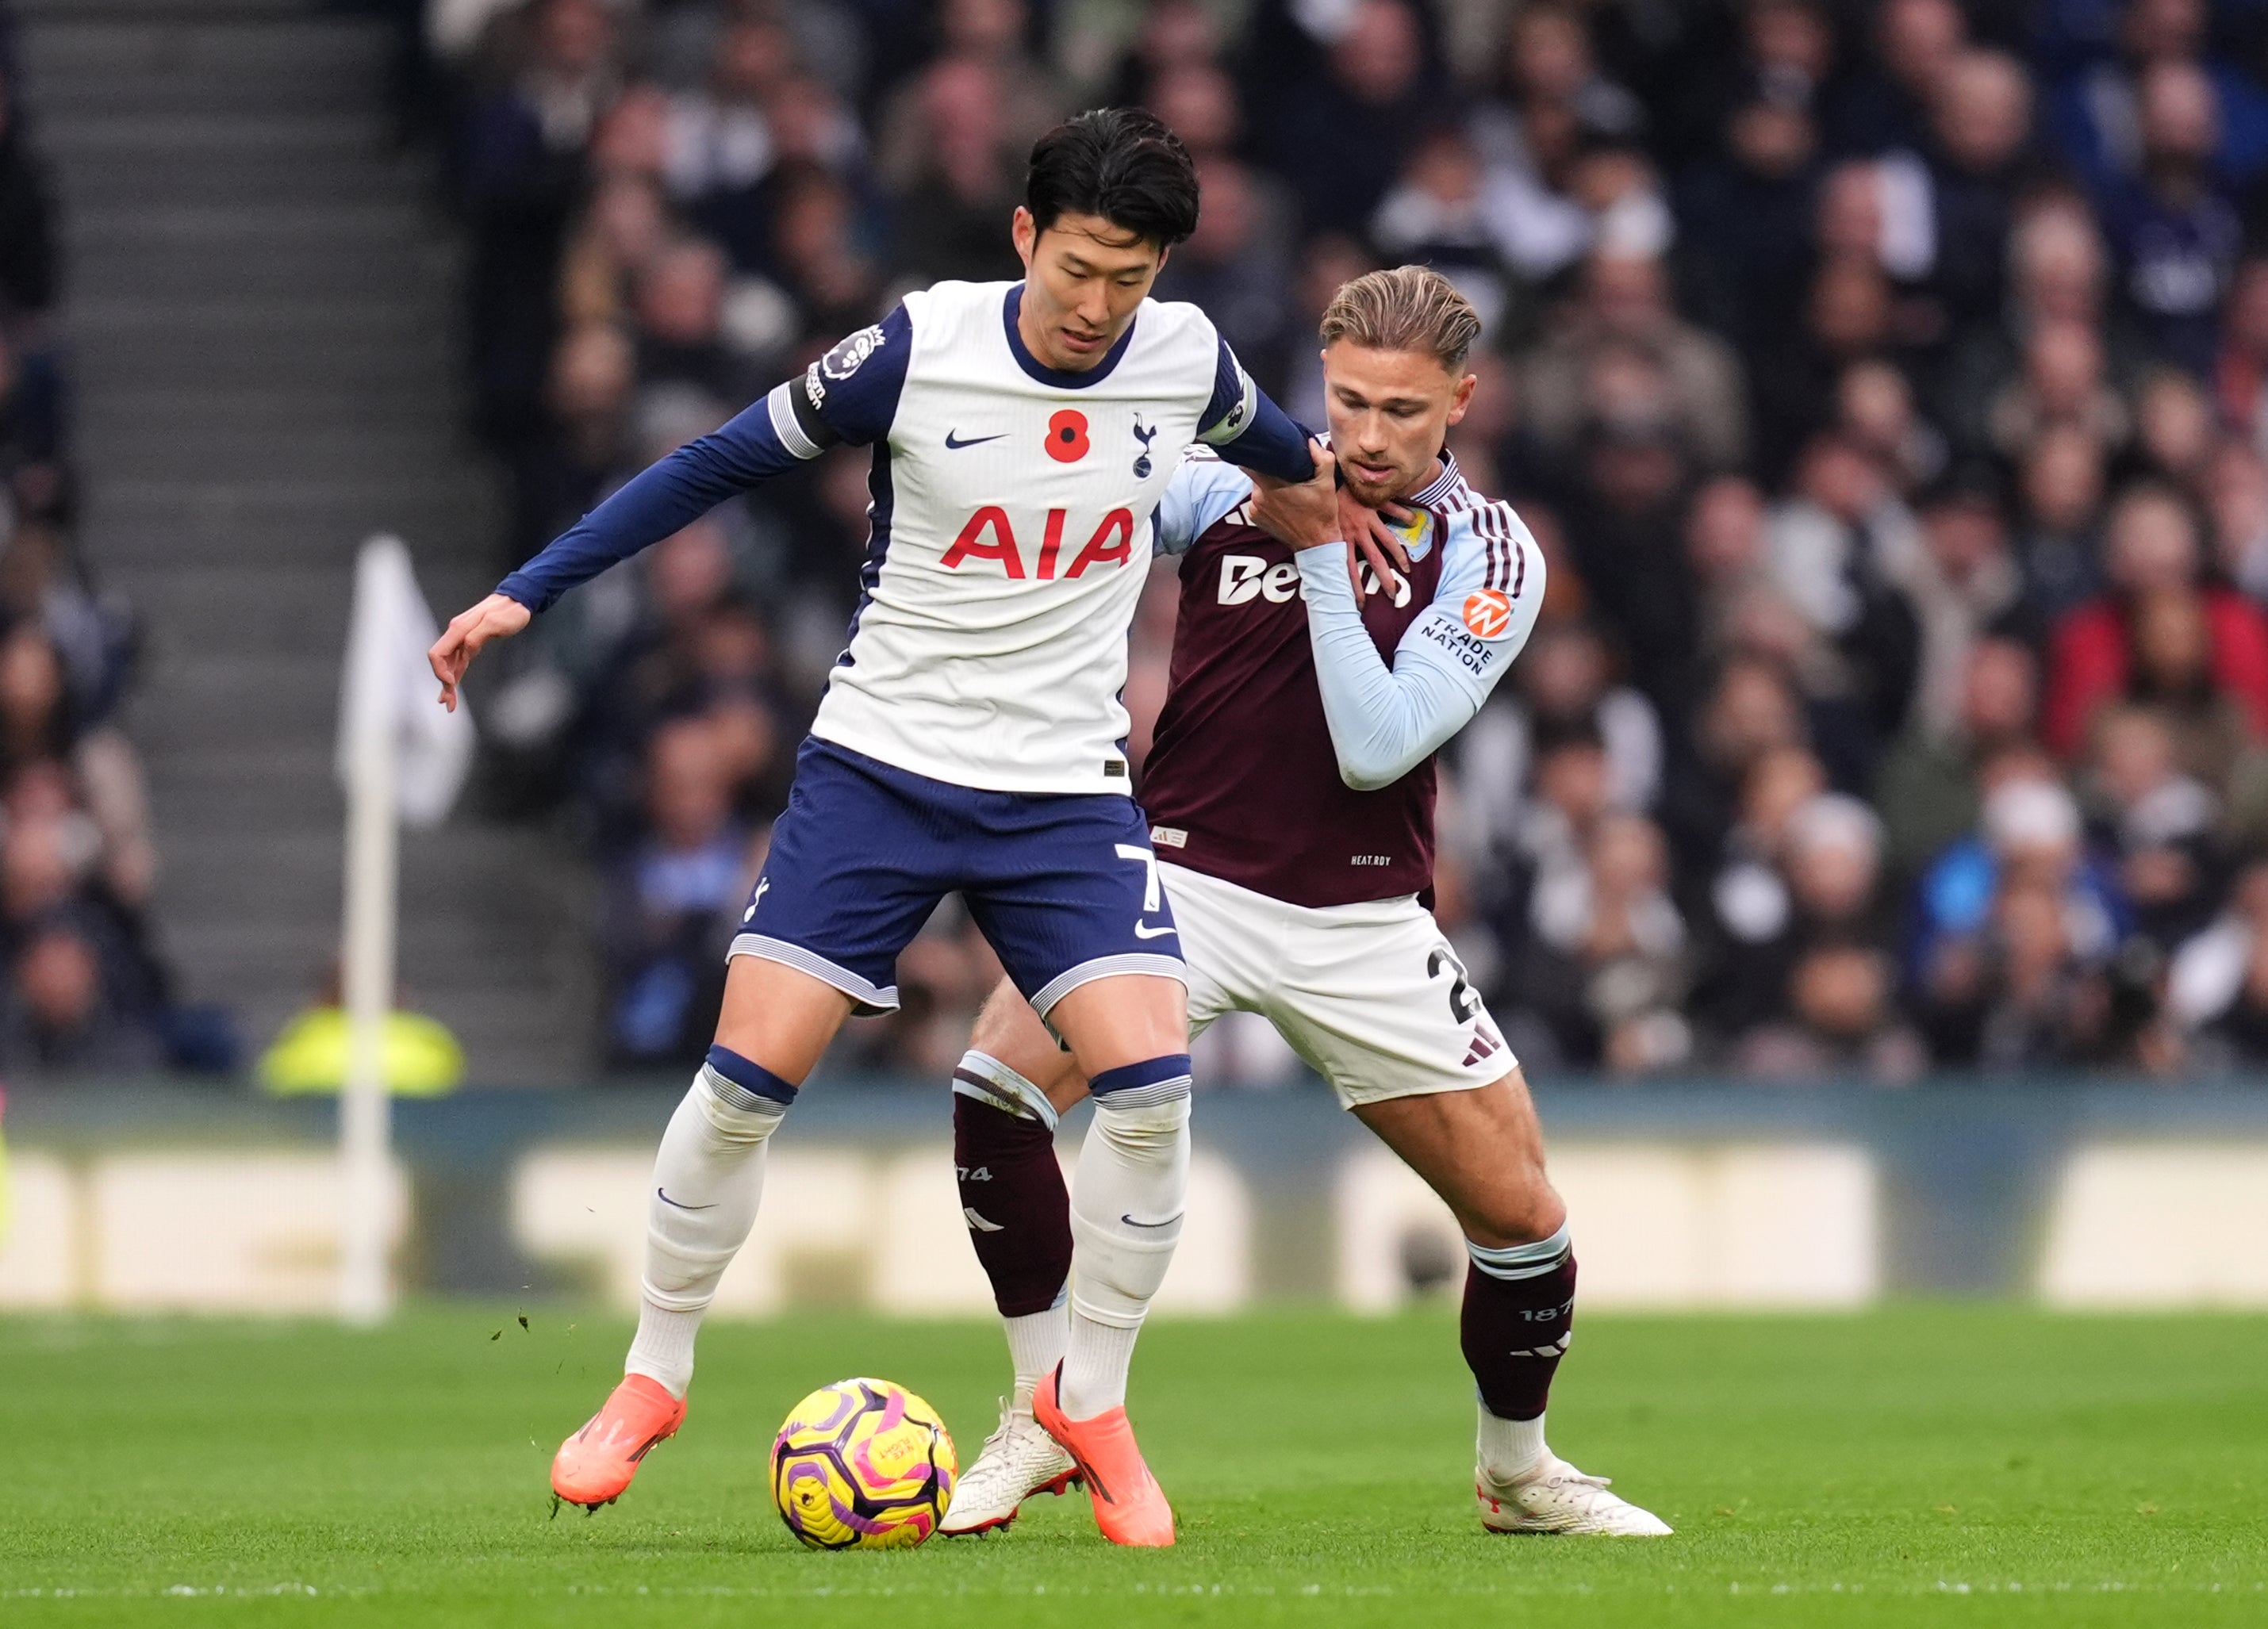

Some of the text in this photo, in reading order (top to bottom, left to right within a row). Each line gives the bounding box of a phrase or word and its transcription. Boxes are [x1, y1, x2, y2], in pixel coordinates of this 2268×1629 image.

[939, 505, 1134, 580] AIA
[1422, 626, 1483, 676] NATION
[1434, 616, 1493, 665] TRADE
[1114, 843, 1160, 910] 7
[1427, 945, 1483, 1025] 2
